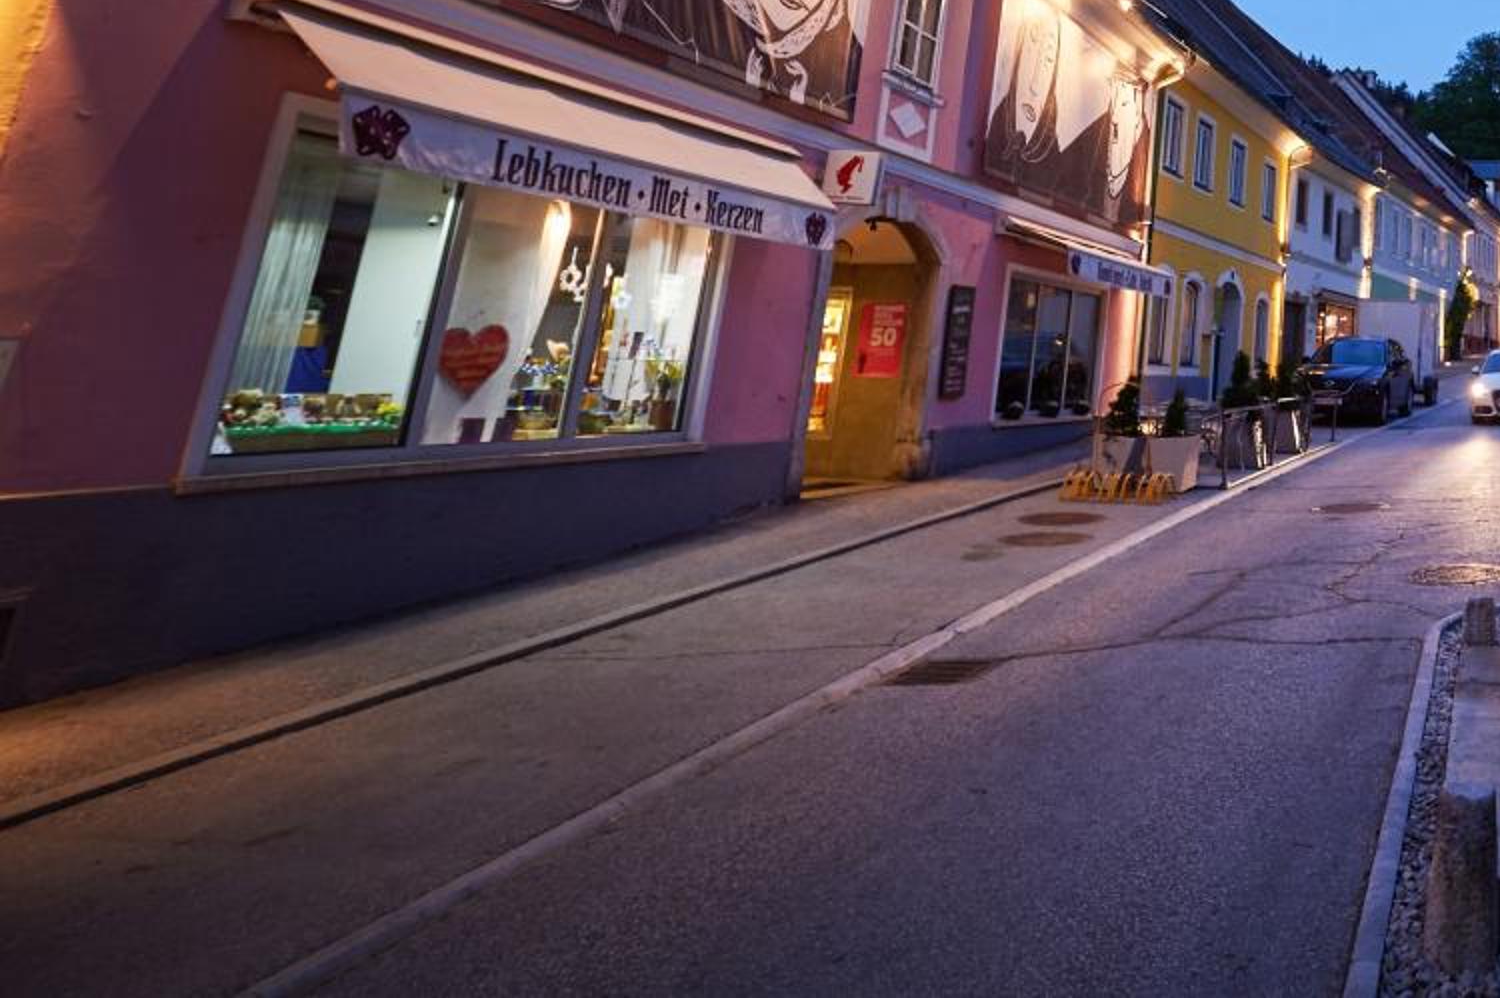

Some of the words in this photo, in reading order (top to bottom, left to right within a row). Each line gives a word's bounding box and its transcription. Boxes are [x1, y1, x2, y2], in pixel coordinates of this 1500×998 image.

[491, 137, 632, 208] Lebkuchen
[648, 175, 689, 219] Met
[704, 189, 765, 234] Kerzen
[870, 327, 897, 347] 50
